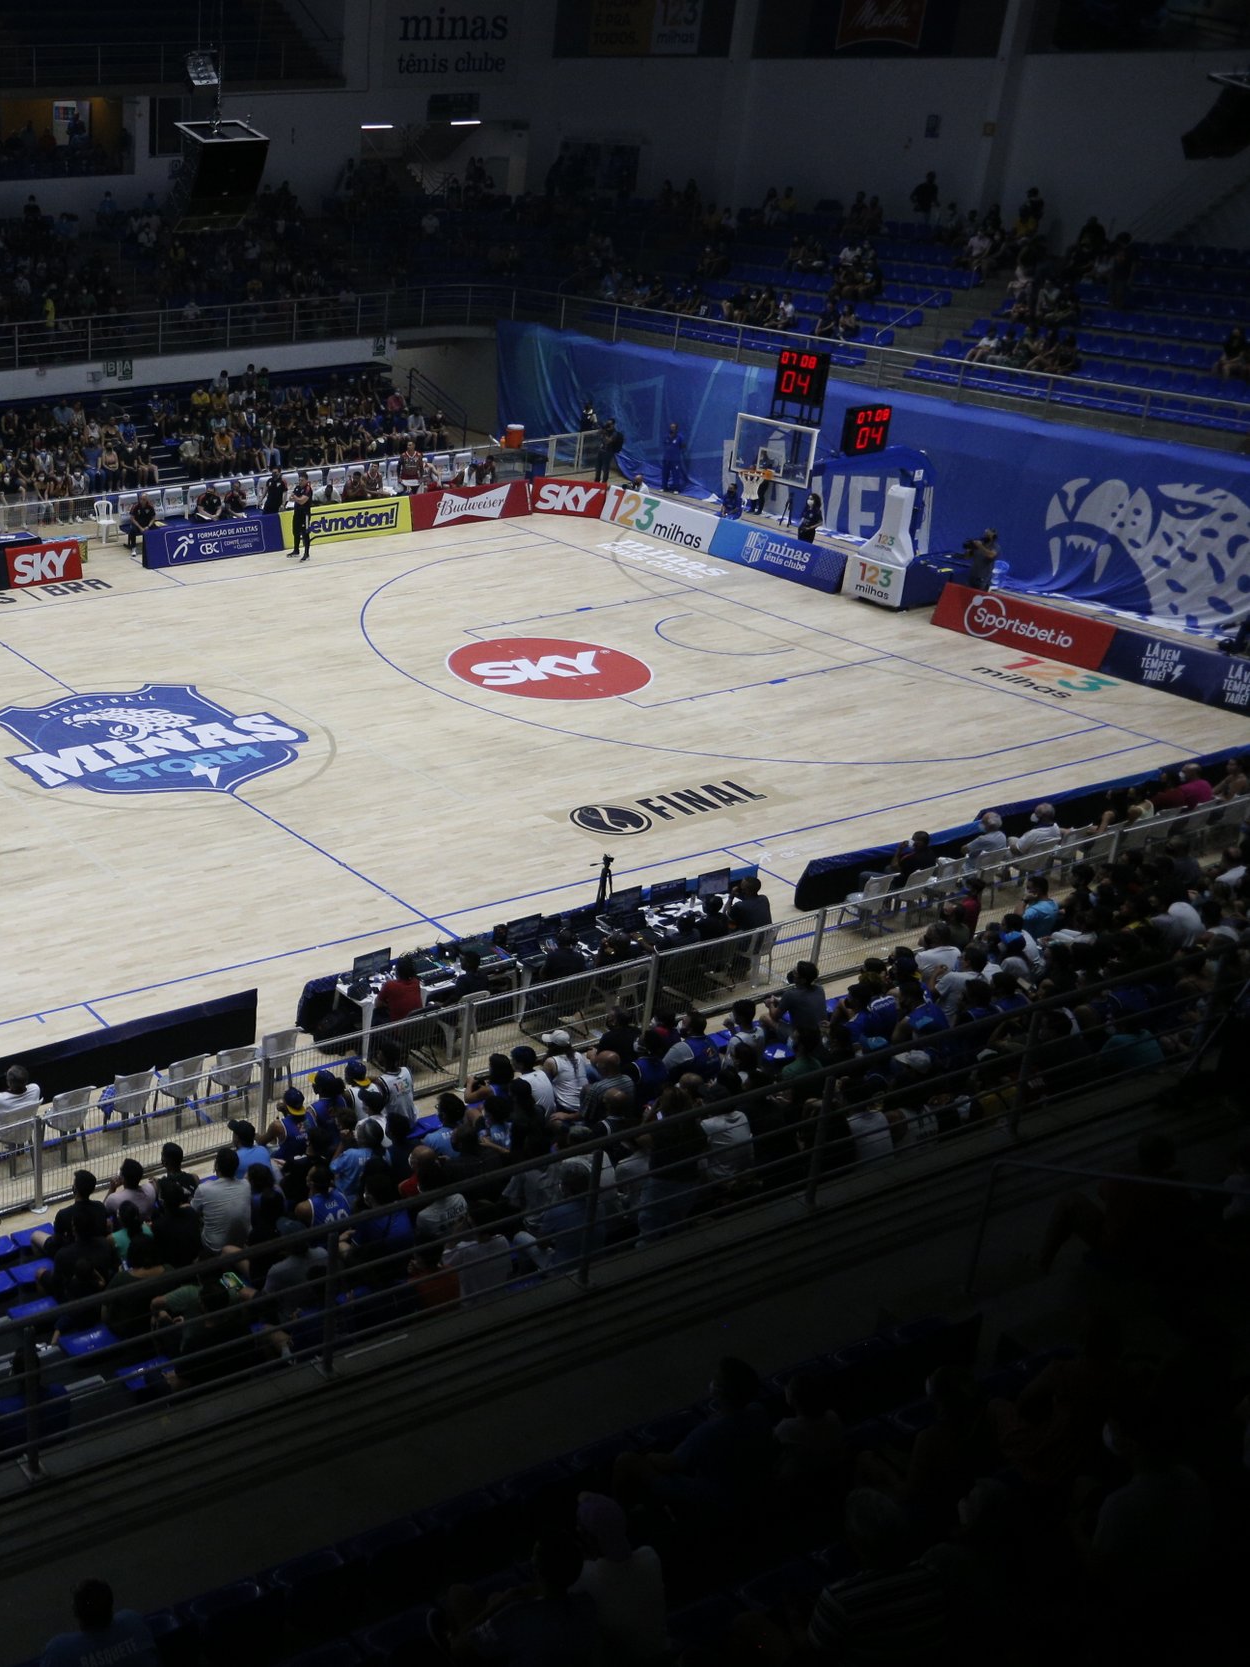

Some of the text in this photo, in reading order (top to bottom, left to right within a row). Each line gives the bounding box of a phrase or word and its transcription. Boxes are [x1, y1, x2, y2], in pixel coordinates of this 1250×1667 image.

[398, 7, 509, 41] minas
[397, 51, 507, 74] tênis clube
[780, 370, 811, 395] 04
[855, 426, 884, 449] 04
[437, 495, 506, 517] Budweiser
[535, 483, 601, 513] SKY
[609, 487, 662, 532] 123
[197, 530, 227, 539] FORMAÇÃO
[236, 525, 259, 534] ATLETAS
[307, 507, 395, 534] etmotion!
[199, 542, 220, 555] CBC
[652, 521, 703, 549] milhas
[878, 534, 895, 546] 123
[762, 551, 806, 572] tênis clube
[765, 537, 811, 564] minas
[13, 548, 72, 585] SKY
[859, 562, 893, 588] 123
[39, 579, 113, 597] BRA
[855, 584, 890, 600] milhas
[973, 607, 1073, 648] Sportsbet.io
[469, 650, 602, 686] SKY
[1141, 657, 1175, 673] TEMPES
[1161, 649, 1181, 662] VEM
[972, 666, 1073, 699] milhas
[1001, 656, 1121, 692] 123
[36, 693, 158, 721] BASKETBALL
[12, 711, 301, 786] MINAS
[104, 746, 265, 783] STORM
[634, 780, 769, 821] FINAL
[79, 1635, 138, 1667] BASQUETE
